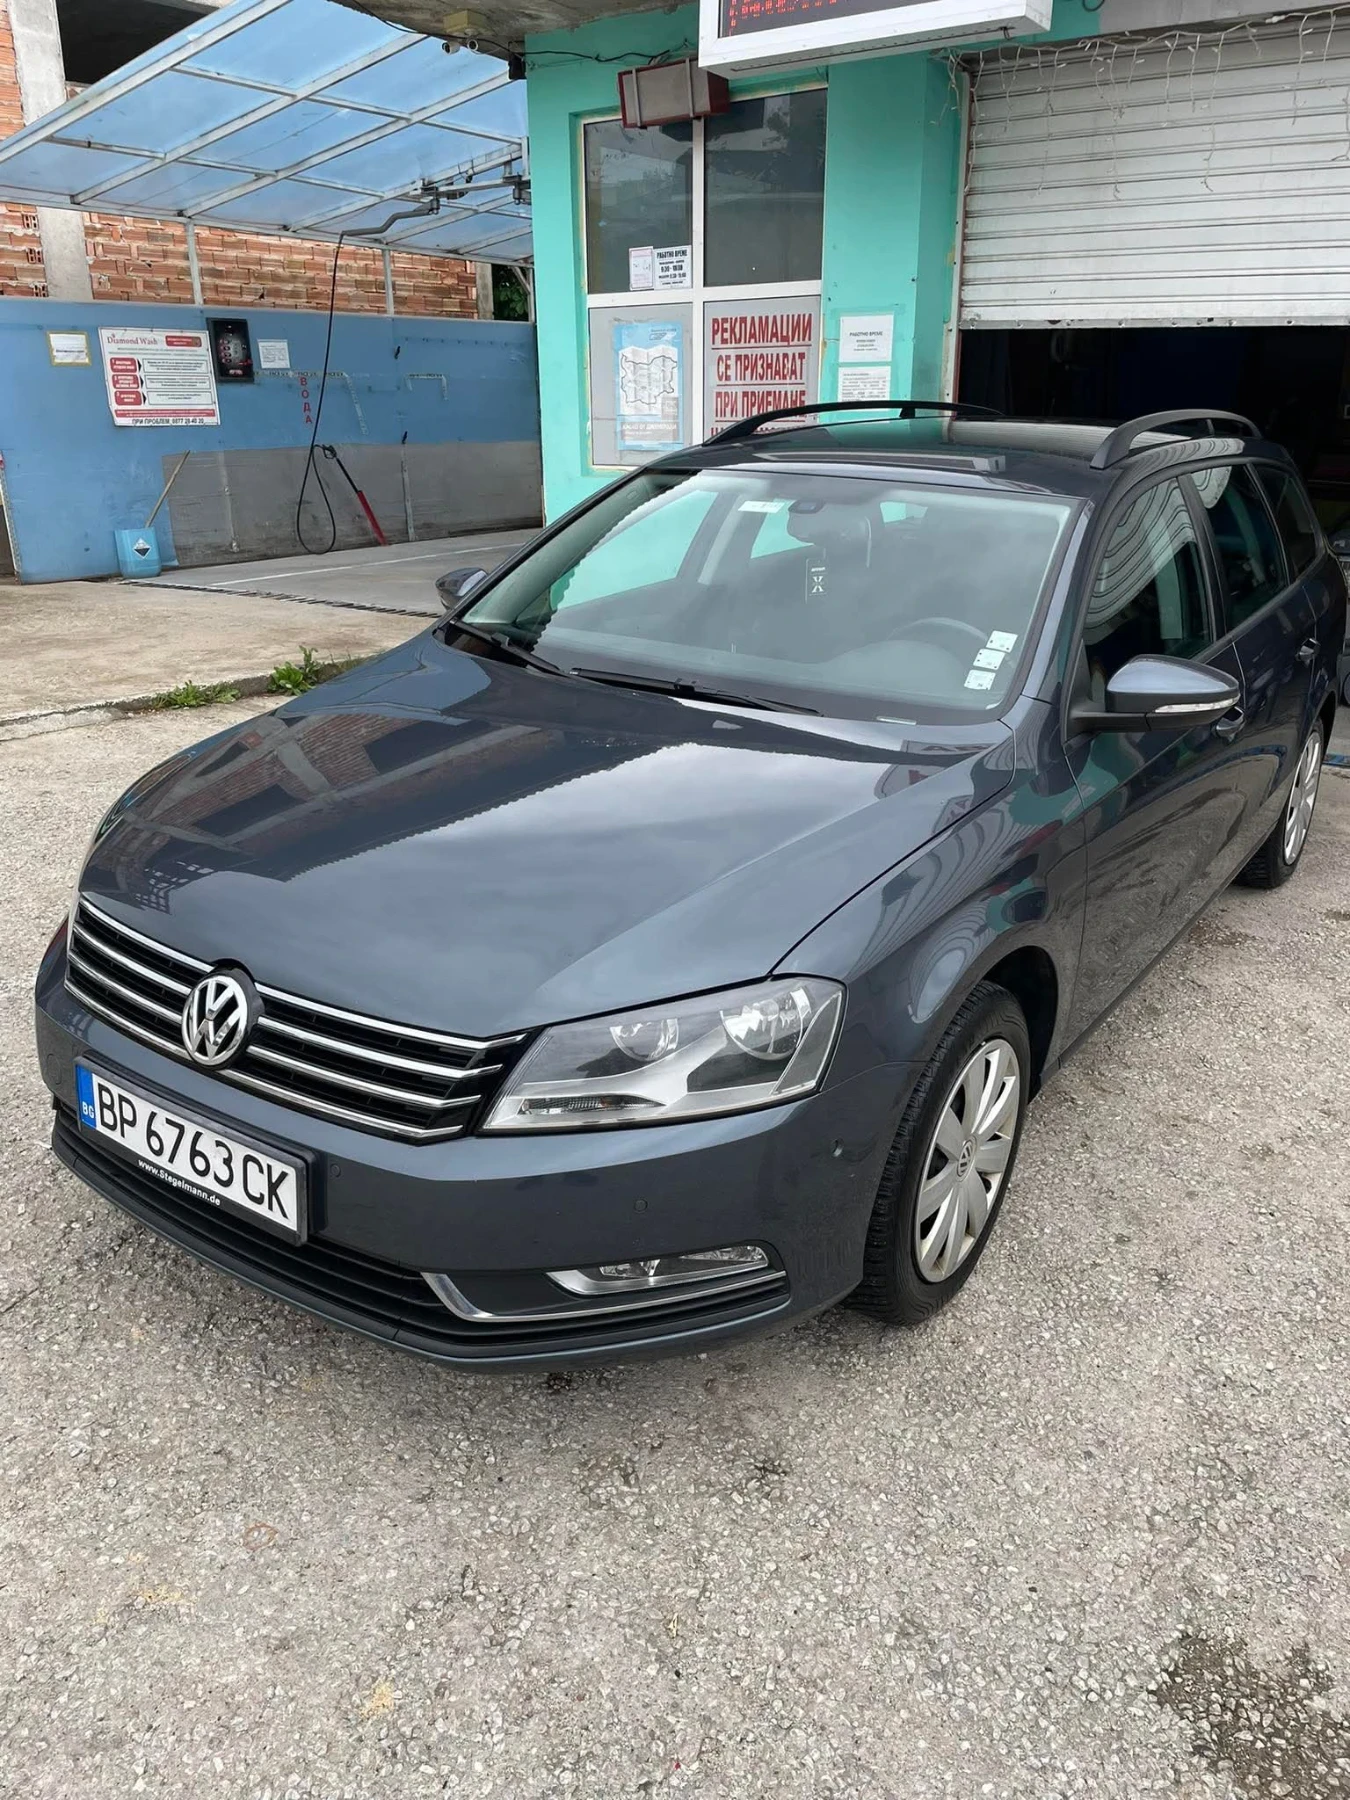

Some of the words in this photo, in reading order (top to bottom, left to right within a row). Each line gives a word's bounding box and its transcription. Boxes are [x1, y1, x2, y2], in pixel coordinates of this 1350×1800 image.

[107, 336, 139, 345] Diamond
[712, 313, 812, 345] РЕКЛАМАЦИИ
[717, 354, 731, 381] СЕ
[735, 352, 806, 381] ПРИЗНАВАТ
[300, 377, 313, 423] ВОДА
[715, 391, 738, 418] ПРИ
[82, 1101, 95, 1119] BG
[97, 1083, 137, 1138] BP
[146, 1111, 234, 1188] 6763
[242, 1154, 289, 1219] CK
[138, 1158, 221, 1206] www.Stegelmann.de
